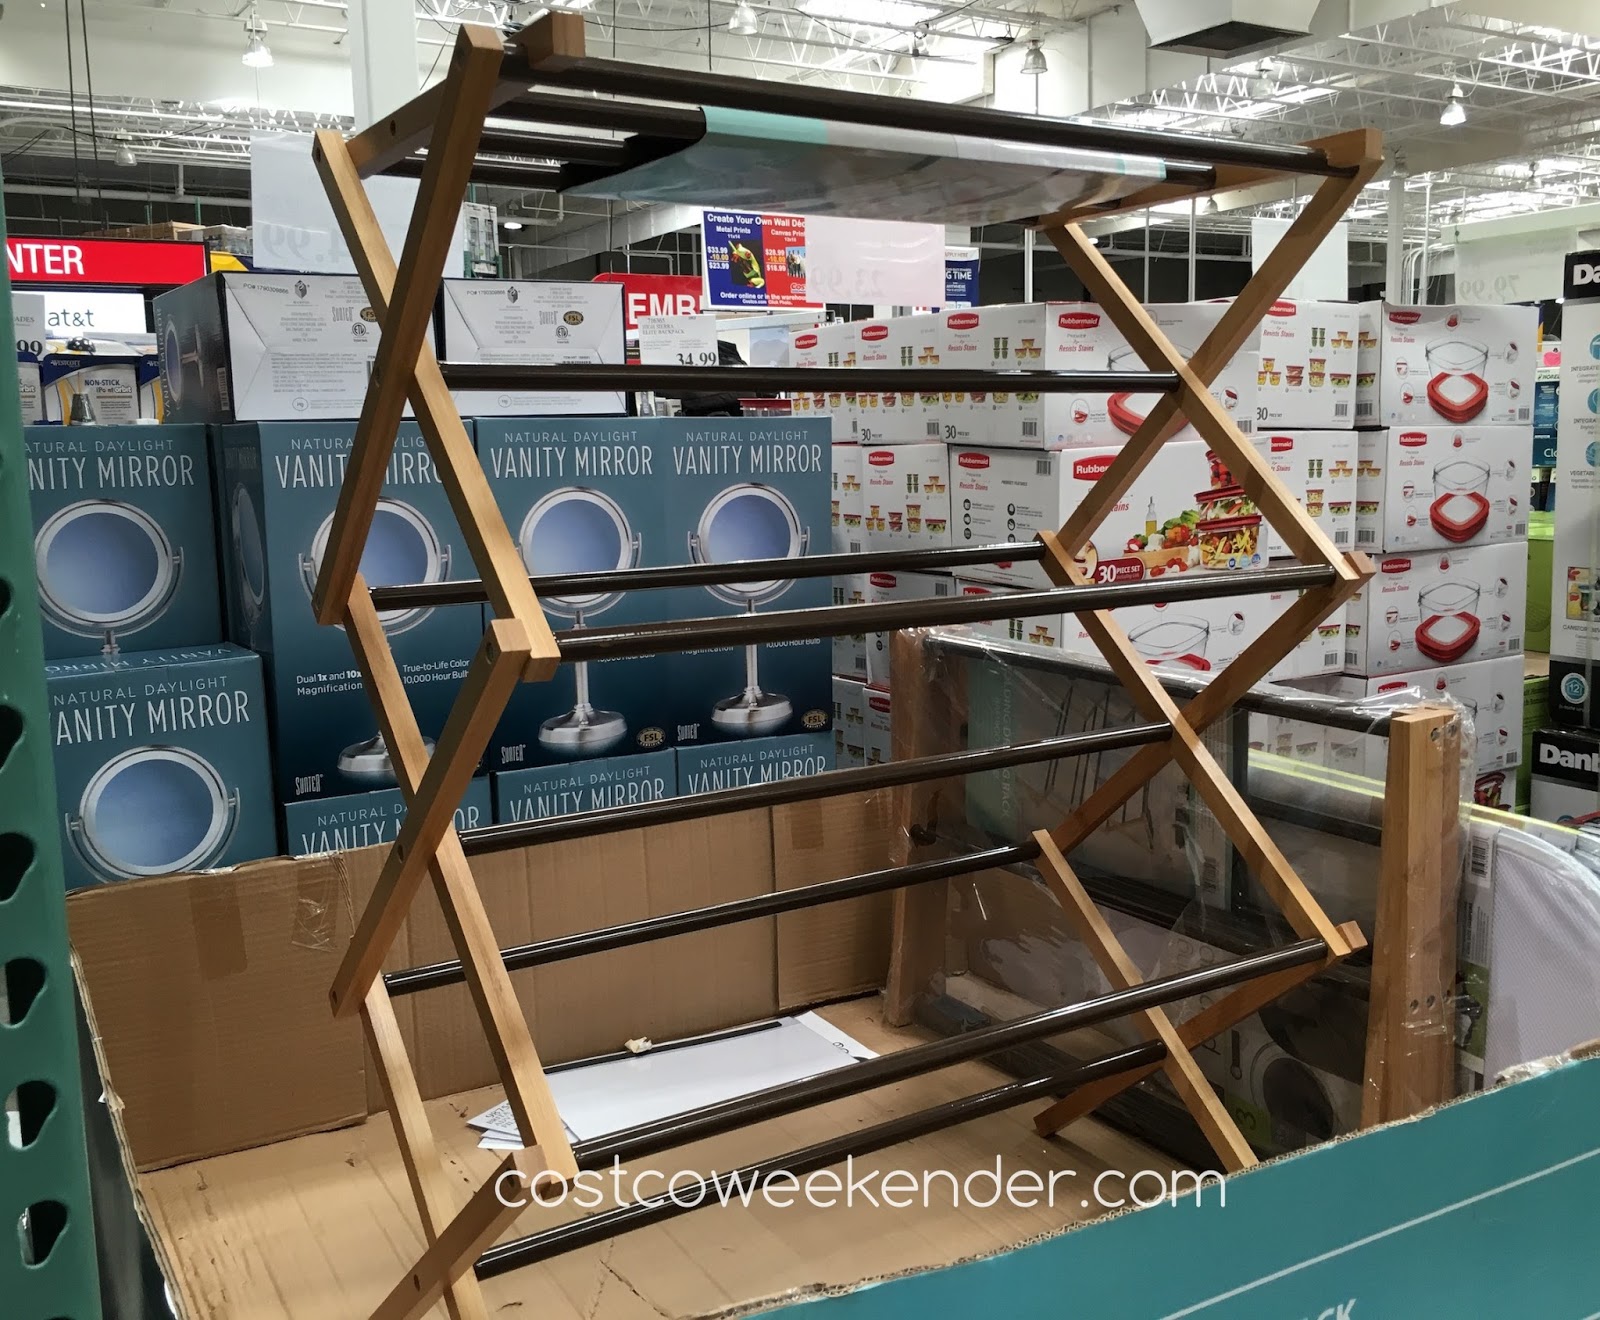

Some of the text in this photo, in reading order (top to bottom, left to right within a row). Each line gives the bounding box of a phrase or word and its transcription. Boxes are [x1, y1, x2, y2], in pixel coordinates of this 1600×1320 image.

[707, 213, 734, 224] Create
[735, 215, 754, 225] Your
[755, 216, 773, 226] Own
[773, 218, 790, 227] Wall
[716, 225, 751, 235] Metal Prints
[707, 245, 728, 254] $33.99
[709, 261, 730, 270] $23.99
[953, 271, 973, 280] TIME
[738, 292, 757, 300] online
[48, 308, 95, 327] at&t
[948, 317, 978, 326] Rubbermaid
[1280, 330, 1294, 338] Stains
[16, 340, 43, 357] 99
[1058, 344, 1077, 352] Resists
[676, 352, 717, 365] 34.99
[1257, 407, 1268, 421] 30
[505, 430, 637, 443] NATURAL DAYLIGHT
[686, 430, 808, 442] NATURAL DAYLIGHT
[861, 428, 871, 441] 30
[945, 425, 956, 439] 30
[95, 439, 174, 452] DAYLIGHT
[490, 445, 653, 479] VANITY MIRROR
[673, 444, 822, 475] VANITY MIRROR
[960, 457, 988, 465] Rubbermaid
[28, 457, 86, 490] NITY
[97, 454, 194, 489] MIRROR
[386, 452, 443, 485] IRR
[1276, 464, 1291, 472] Stains
[1098, 565, 1141, 583] 30 PIECE SET
[403, 659, 470, 673] True-to-Life Color
[296, 670, 363, 684] Dual 1x and 10x
[403, 674, 431, 685] 10,000
[432, 673, 451, 682] Hour
[54, 675, 228, 706] NATURAL DAYLIGHT
[297, 682, 363, 696] Magnification
[1570, 683, 1580, 694] 12
[48, 690, 250, 746] ANITY MIRROR
[644, 733, 659, 742] FSL
[700, 744, 814, 769] NATURAL DAYLIGHT
[523, 765, 651, 794] NATURAL DAYLIGHT
[688, 755, 826, 794] VANITY MIRROR
[510, 777, 665, 822] VANITY MIRROR
[317, 806, 387, 827] NATURAL
[302, 820, 386, 855] VANITY
